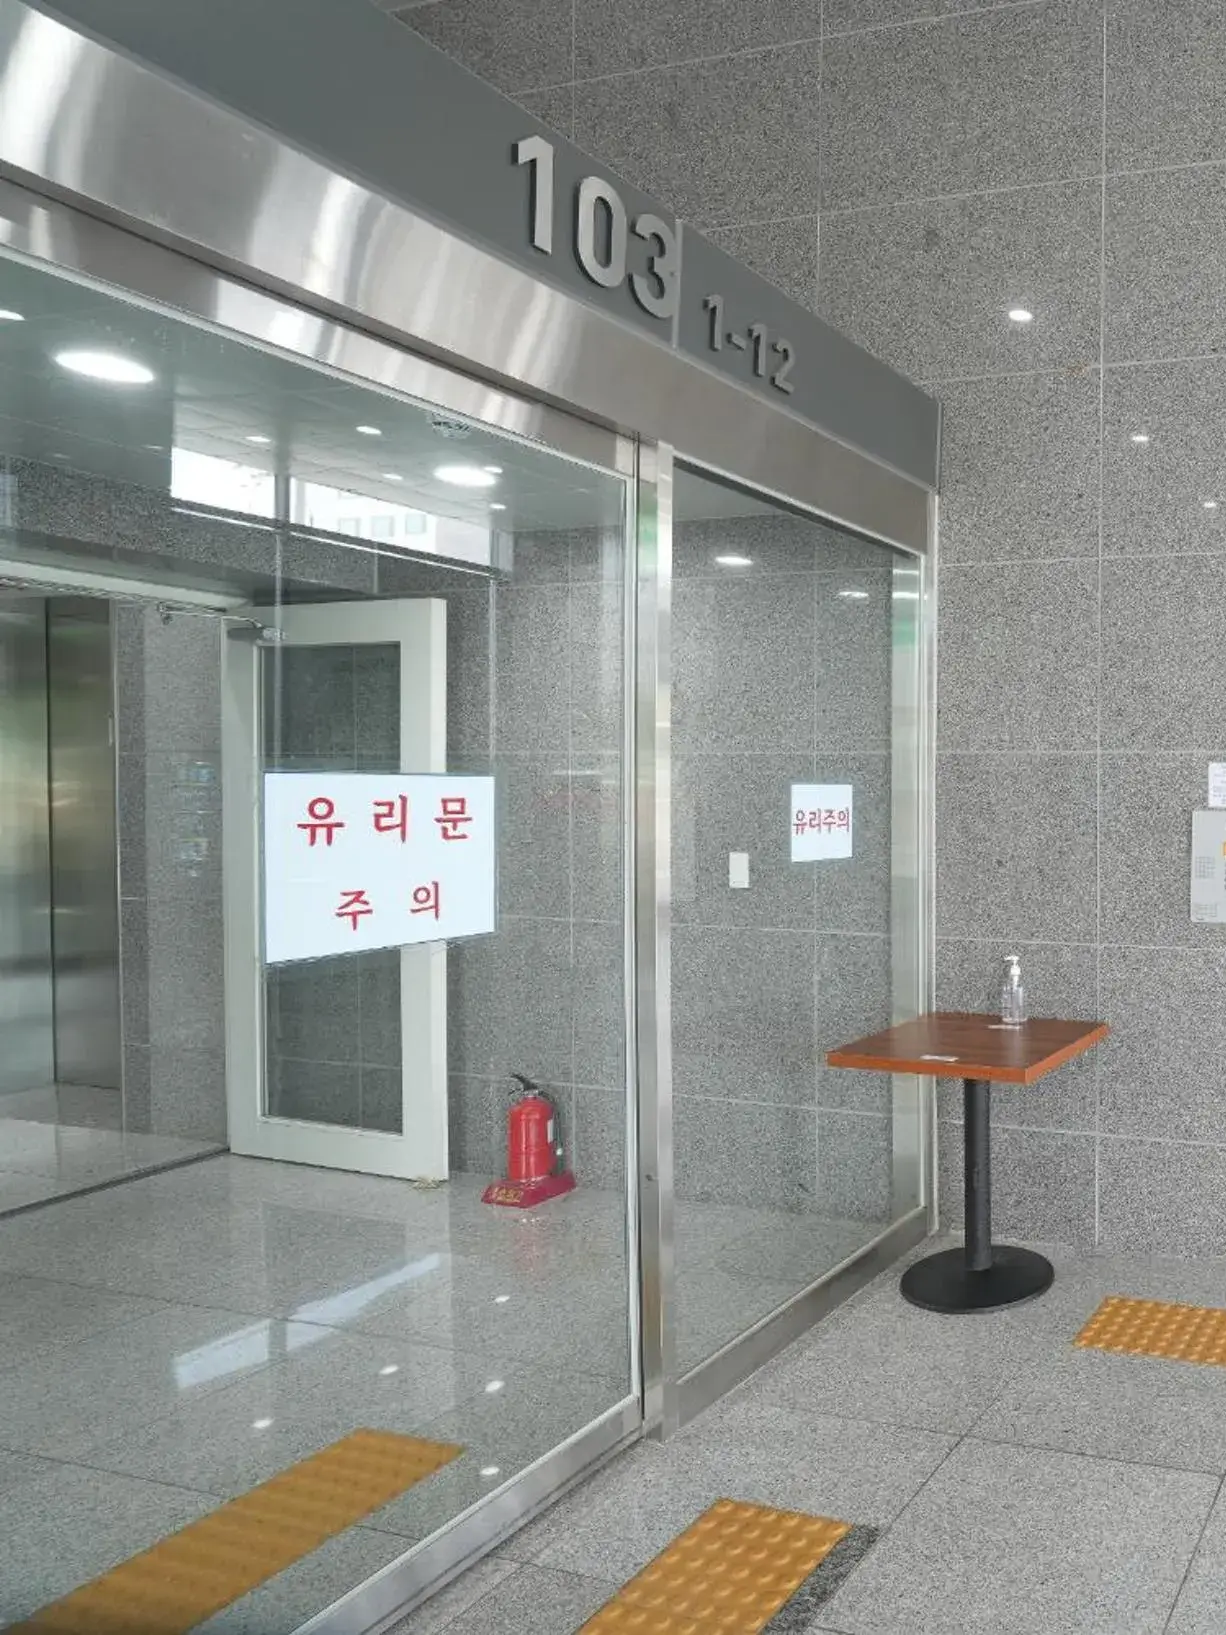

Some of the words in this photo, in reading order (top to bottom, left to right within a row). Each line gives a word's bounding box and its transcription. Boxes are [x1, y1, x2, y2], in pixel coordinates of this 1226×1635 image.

[512, 135, 682, 319] 103
[703, 294, 795, 394] 1-12
[793, 807, 850, 835] 유리주의
